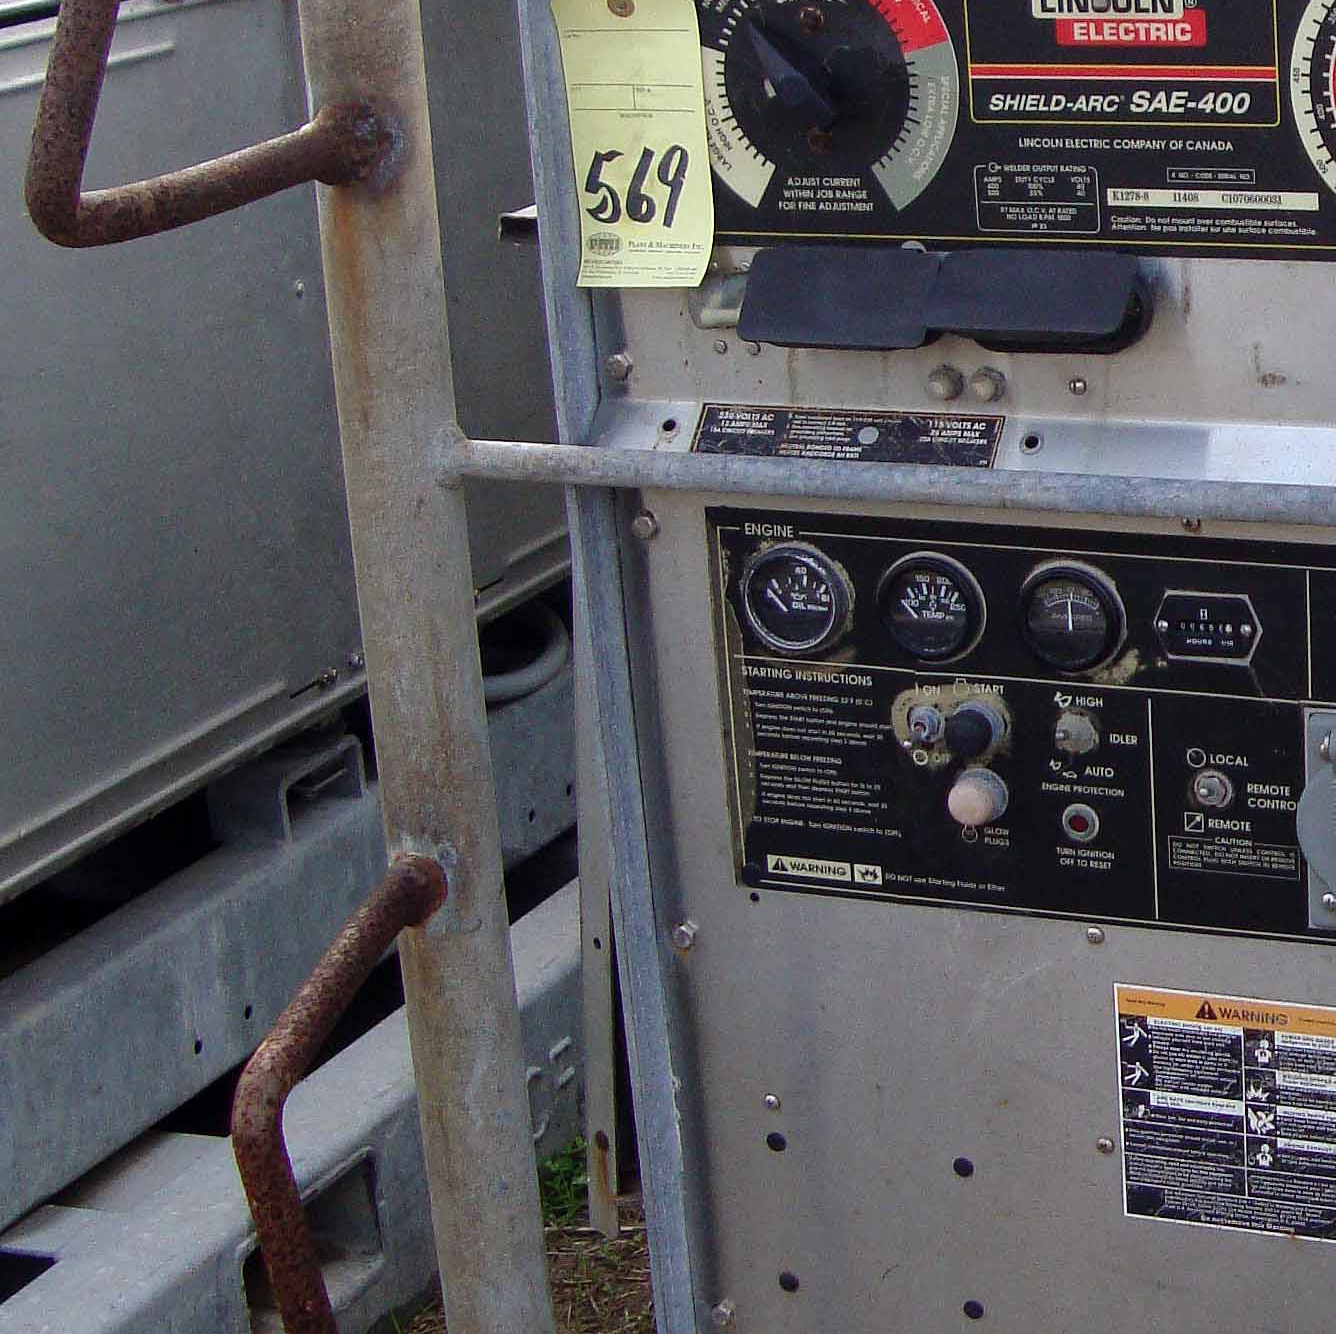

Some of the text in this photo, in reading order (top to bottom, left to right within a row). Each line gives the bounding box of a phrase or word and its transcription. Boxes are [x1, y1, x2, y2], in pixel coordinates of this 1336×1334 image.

[1073, 22, 1193, 42] ELECTRIC
[988, 90, 1251, 114] SHIELD-ARC SAE-400
[1018, 137, 1234, 152] LINCOLN ELECTRIC COMPANY OF CANADA
[1003, 164, 1031, 172] WELDER
[585, 144, 690, 228] 569
[786, 176, 861, 187] ADJUST CURRENT
[782, 188, 868, 199] WITHIN JOB RANGE
[778, 200, 874, 212] FOR FINE ADJUSTMENT
[761, 412, 775, 421] AC
[946, 420, 972, 429] VOLTS
[972, 421, 987, 430] AC
[744, 523, 794, 539] ENGINE
[741, 665, 873, 687] STARTING INSTRUCTIONS
[921, 684, 1005, 696] ON START
[1075, 695, 1104, 708] HIGH
[1109, 733, 1139, 746] IDLER
[1209, 754, 1249, 767] LOCAL
[1084, 766, 1115, 778] AUTO
[1041, 781, 1125, 798] ENGINE PROTECTION
[1247, 782, 1291, 797] REMOTE
[1247, 797, 1297, 811] CONTRO
[983, 826, 1010, 836] GLOW
[1208, 818, 1252, 832] REMOTE
[983, 835, 1010, 847] PLUGS
[1214, 836, 1253, 847] CAUTION
[1056, 846, 1115, 860] TURN IGNITION
[790, 861, 847, 878] WARNING
[1059, 857, 1112, 870] OFF TO RESET
[1218, 1005, 1289, 1026] WARNING
